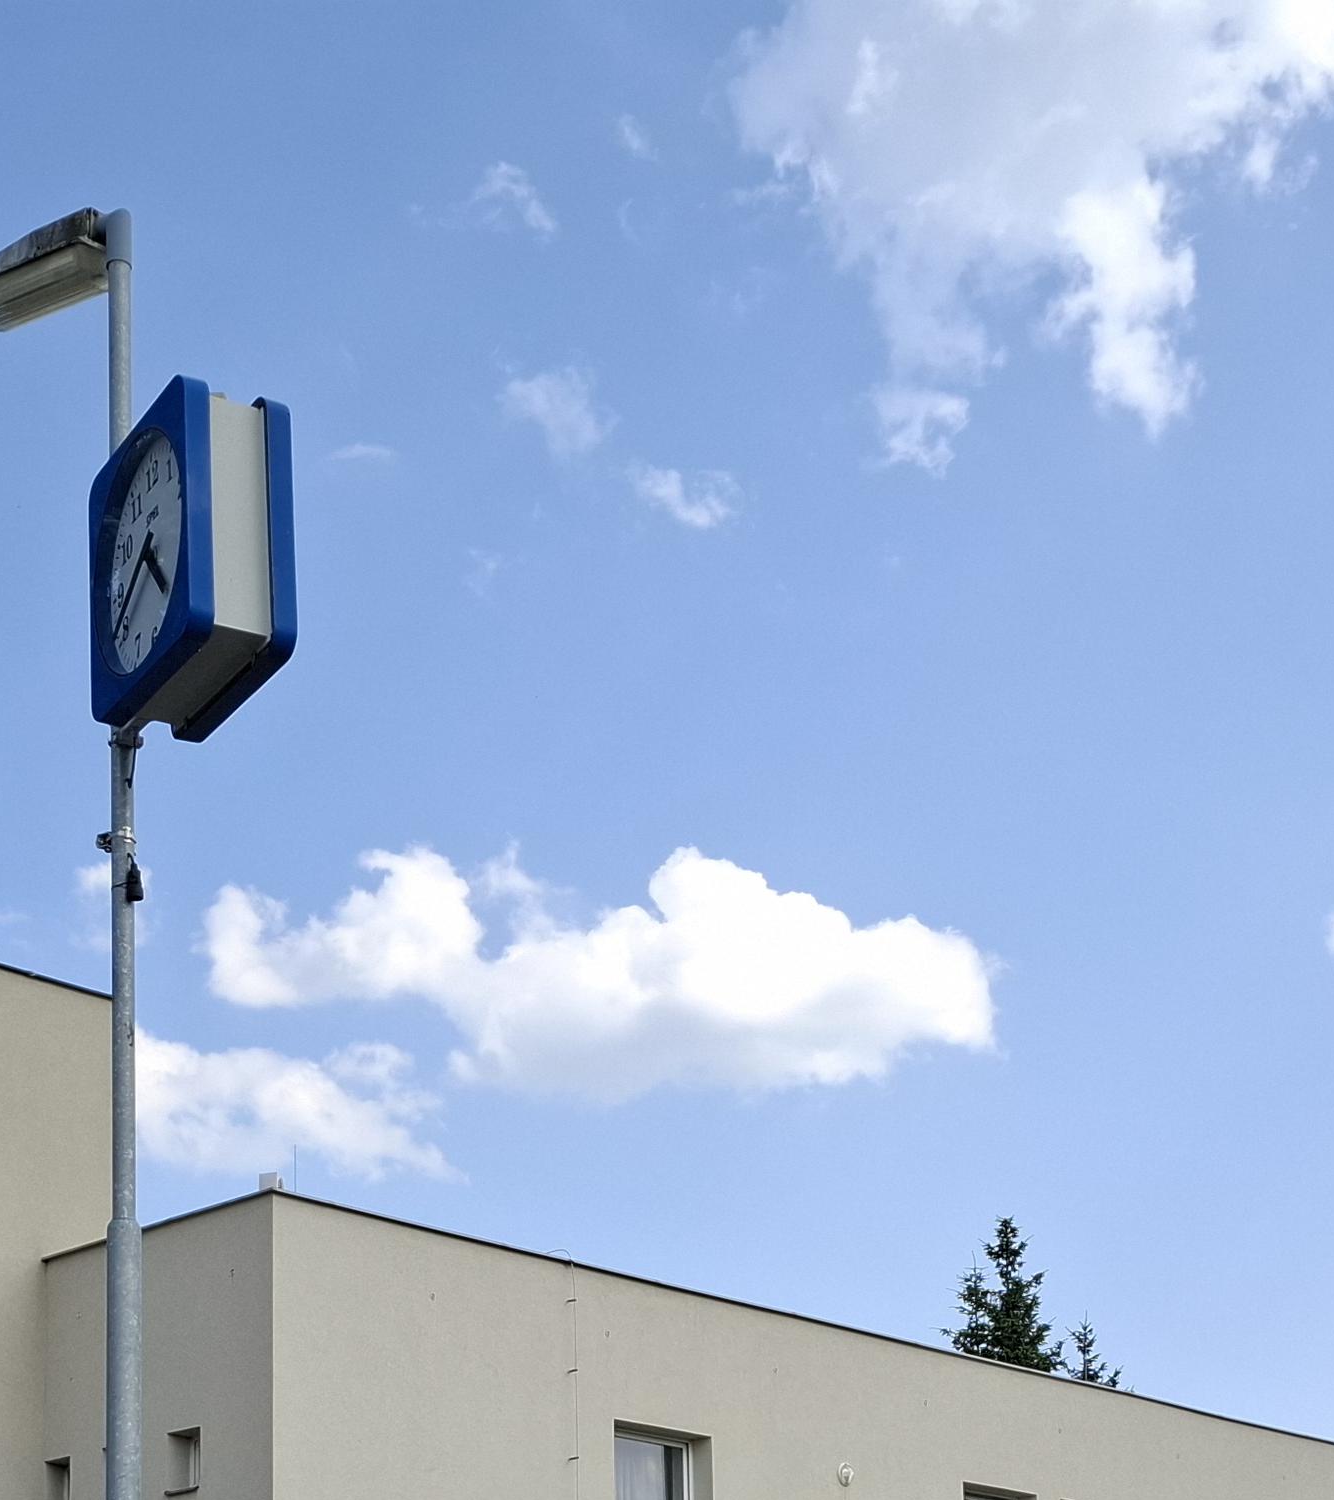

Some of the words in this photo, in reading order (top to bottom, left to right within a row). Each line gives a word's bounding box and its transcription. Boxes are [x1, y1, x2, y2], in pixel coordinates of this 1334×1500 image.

[146, 459, 158, 494] 12
[166, 458, 173, 482] 1
[131, 493, 143, 524] 11
[121, 534, 134, 566] 10
[122, 615, 130, 641] 8
[134, 632, 142, 659] 7
